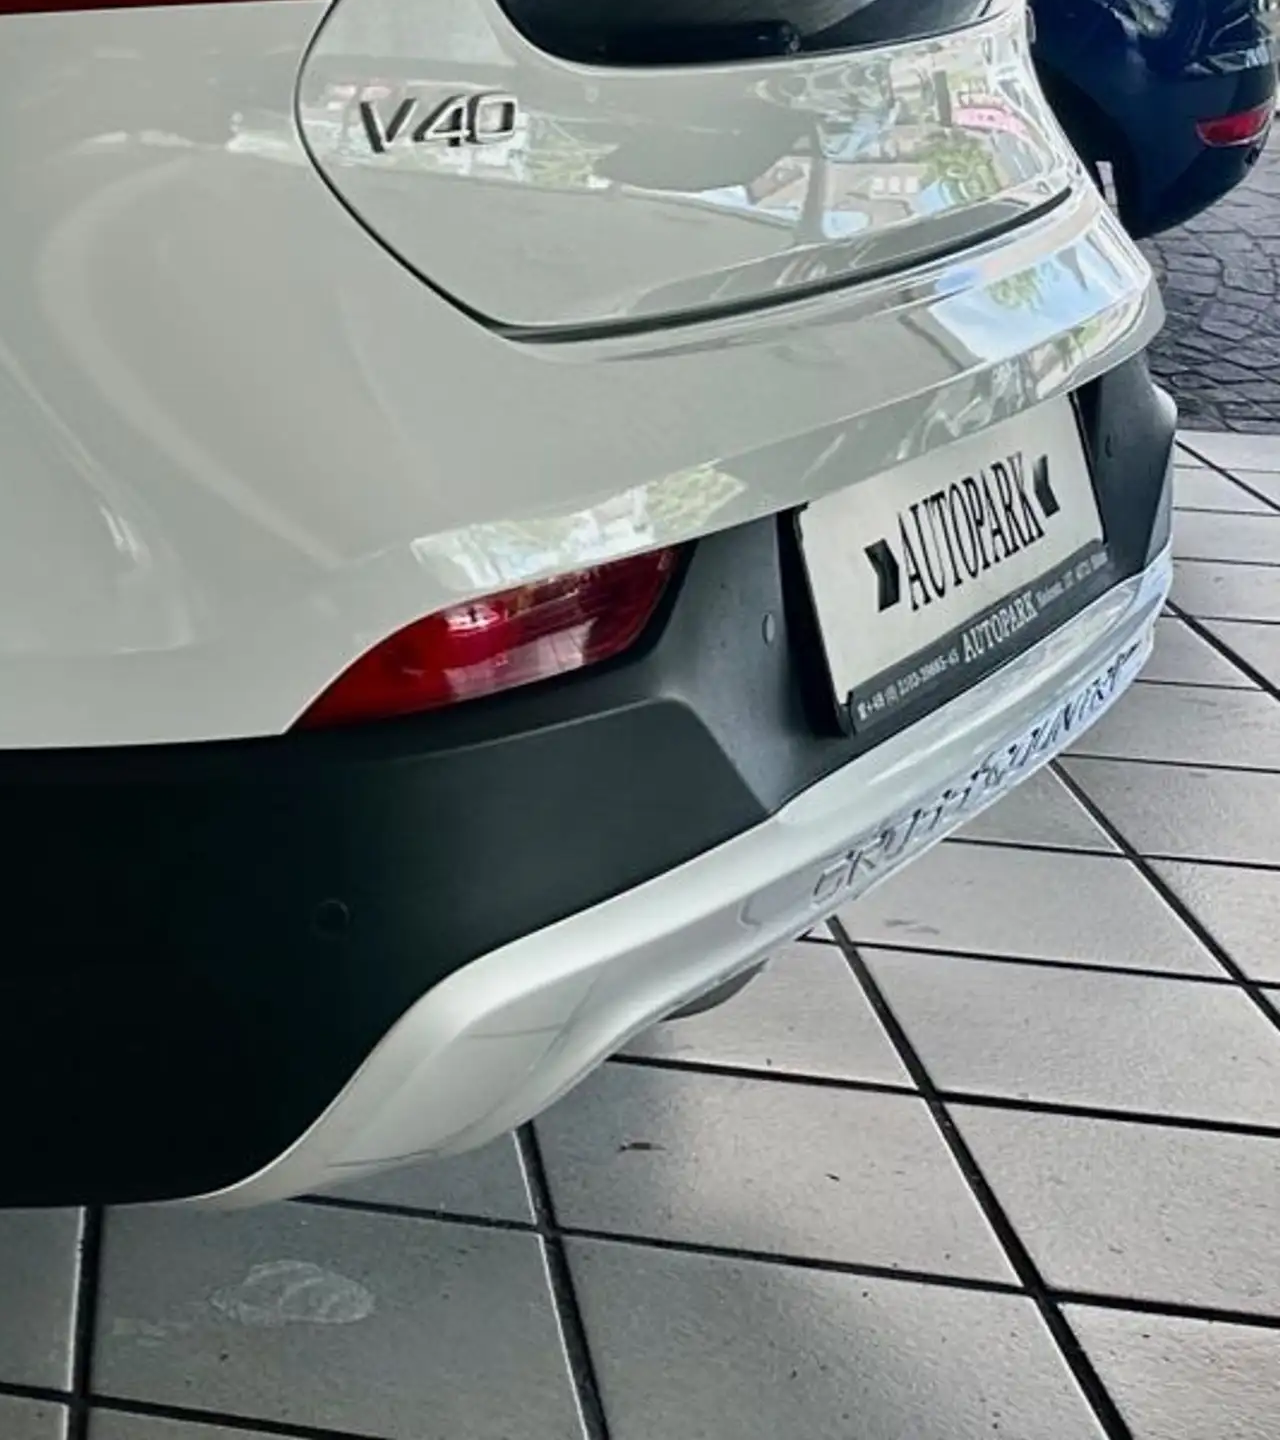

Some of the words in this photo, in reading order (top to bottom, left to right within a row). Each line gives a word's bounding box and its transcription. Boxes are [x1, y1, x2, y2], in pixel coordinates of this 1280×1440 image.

[359, 92, 518, 154] V40
[897, 451, 1045, 611] AUTOPARK
[961, 590, 1039, 663] AUTOPARK
